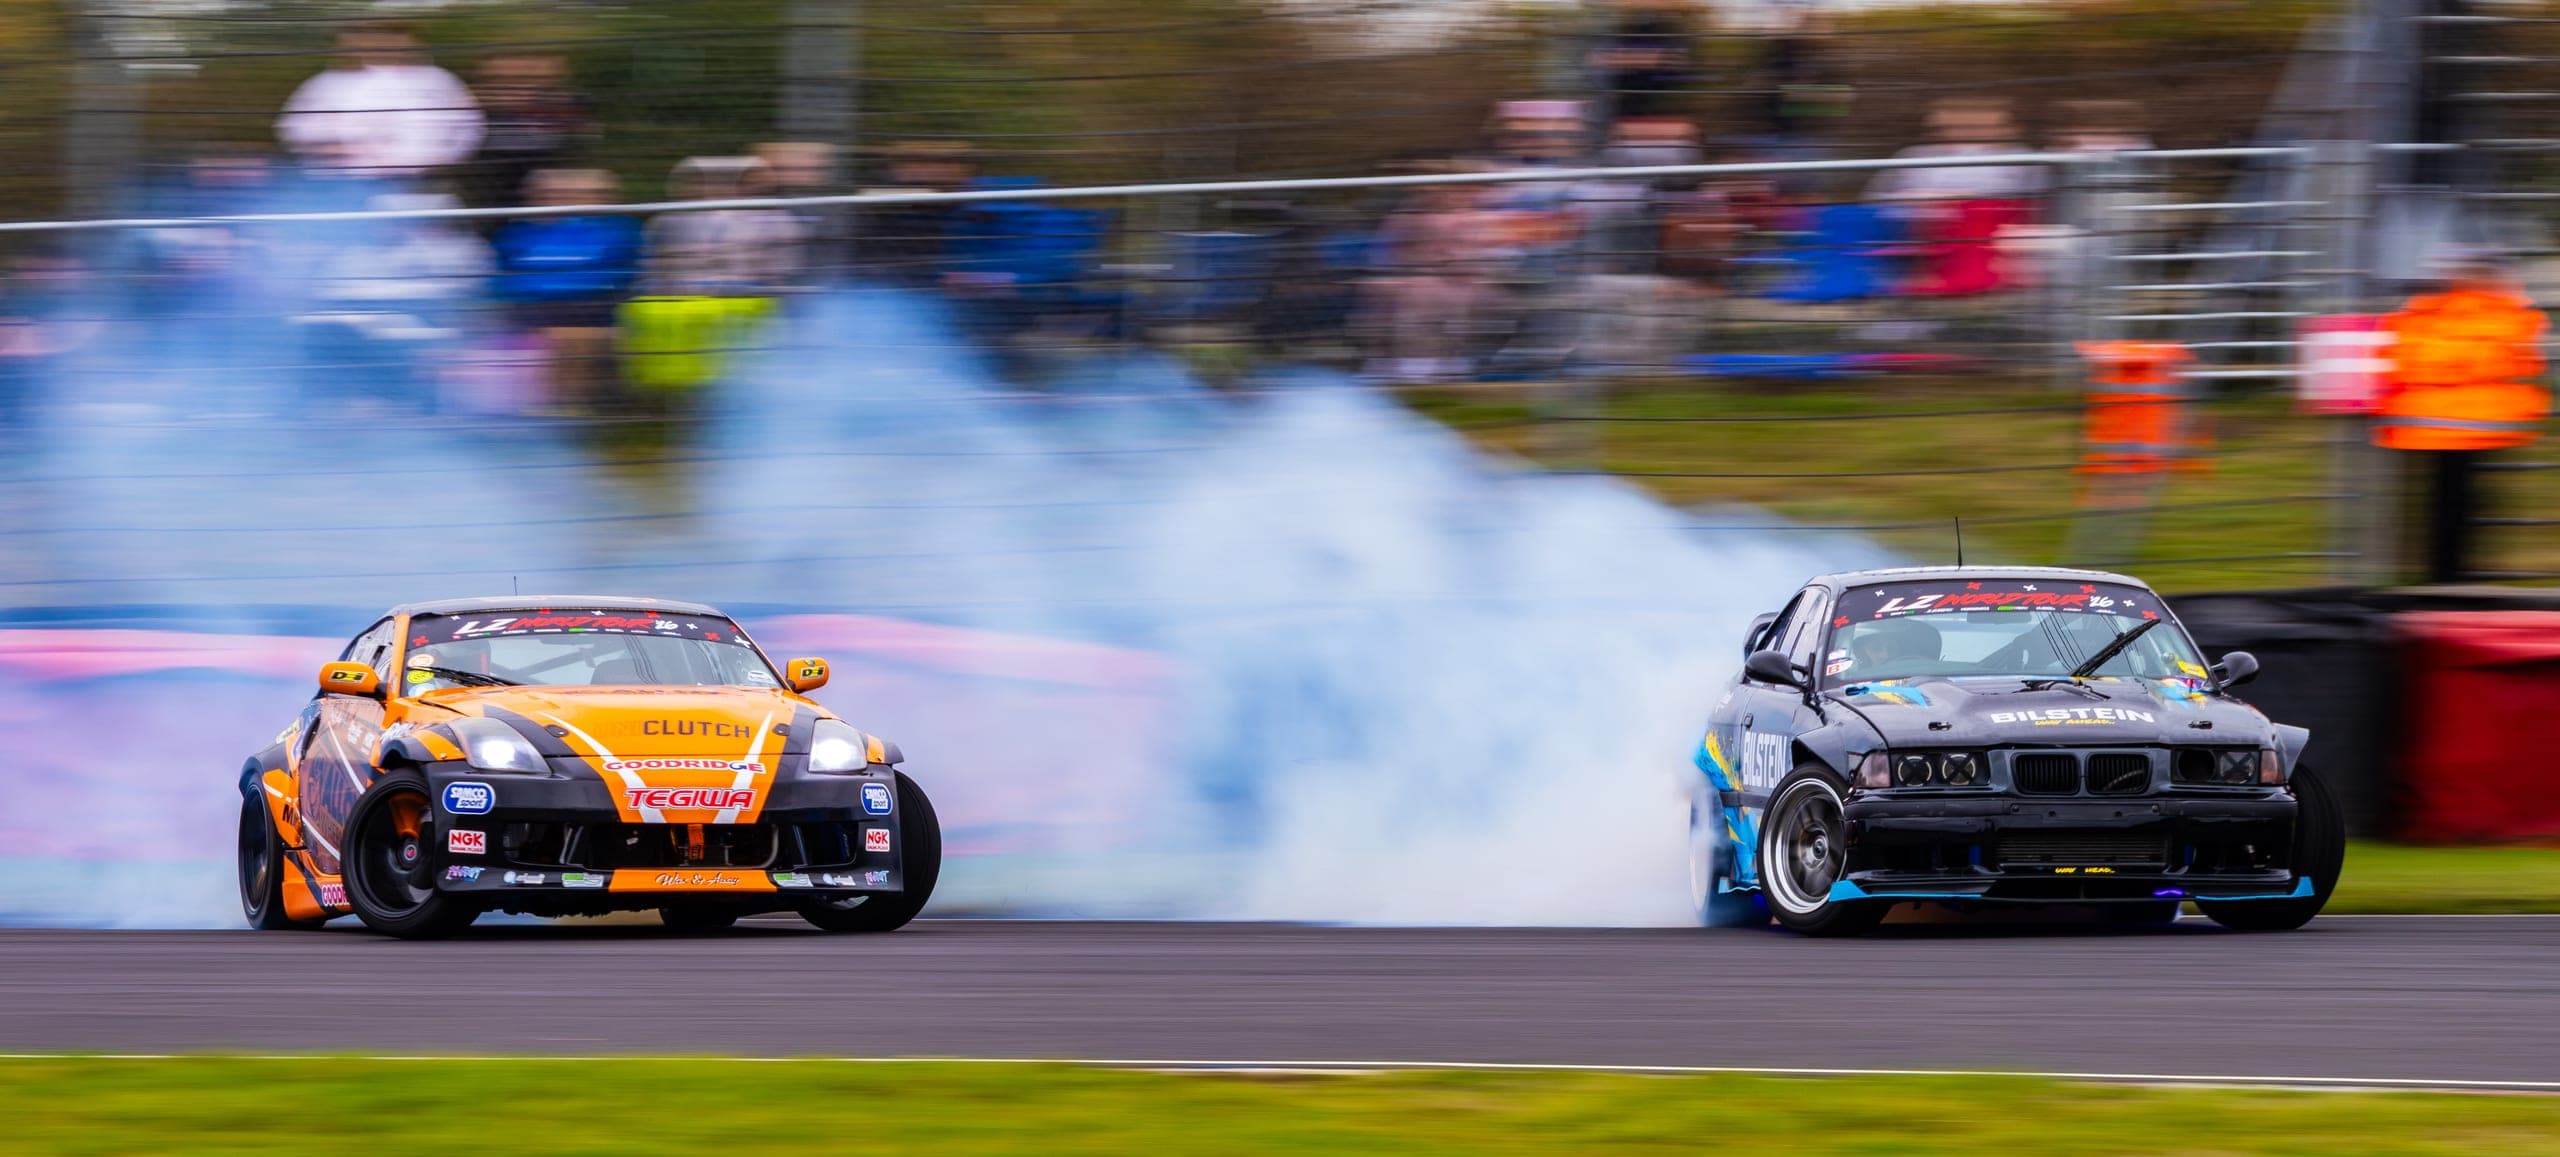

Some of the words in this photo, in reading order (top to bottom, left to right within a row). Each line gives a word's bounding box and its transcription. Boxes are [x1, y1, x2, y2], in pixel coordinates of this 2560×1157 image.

[1876, 594, 1944, 613] LZ
[454, 618, 518, 635] LZ
[1990, 707, 2155, 724] BILSTEIN
[643, 719, 750, 738] CLUTCH
[604, 759, 765, 773] GOODRIDGE
[1743, 731, 1788, 788] BILSTEIN
[627, 789, 755, 809] TEGIWA
[451, 832, 483, 846] NGK
[867, 831, 888, 845] NGK
